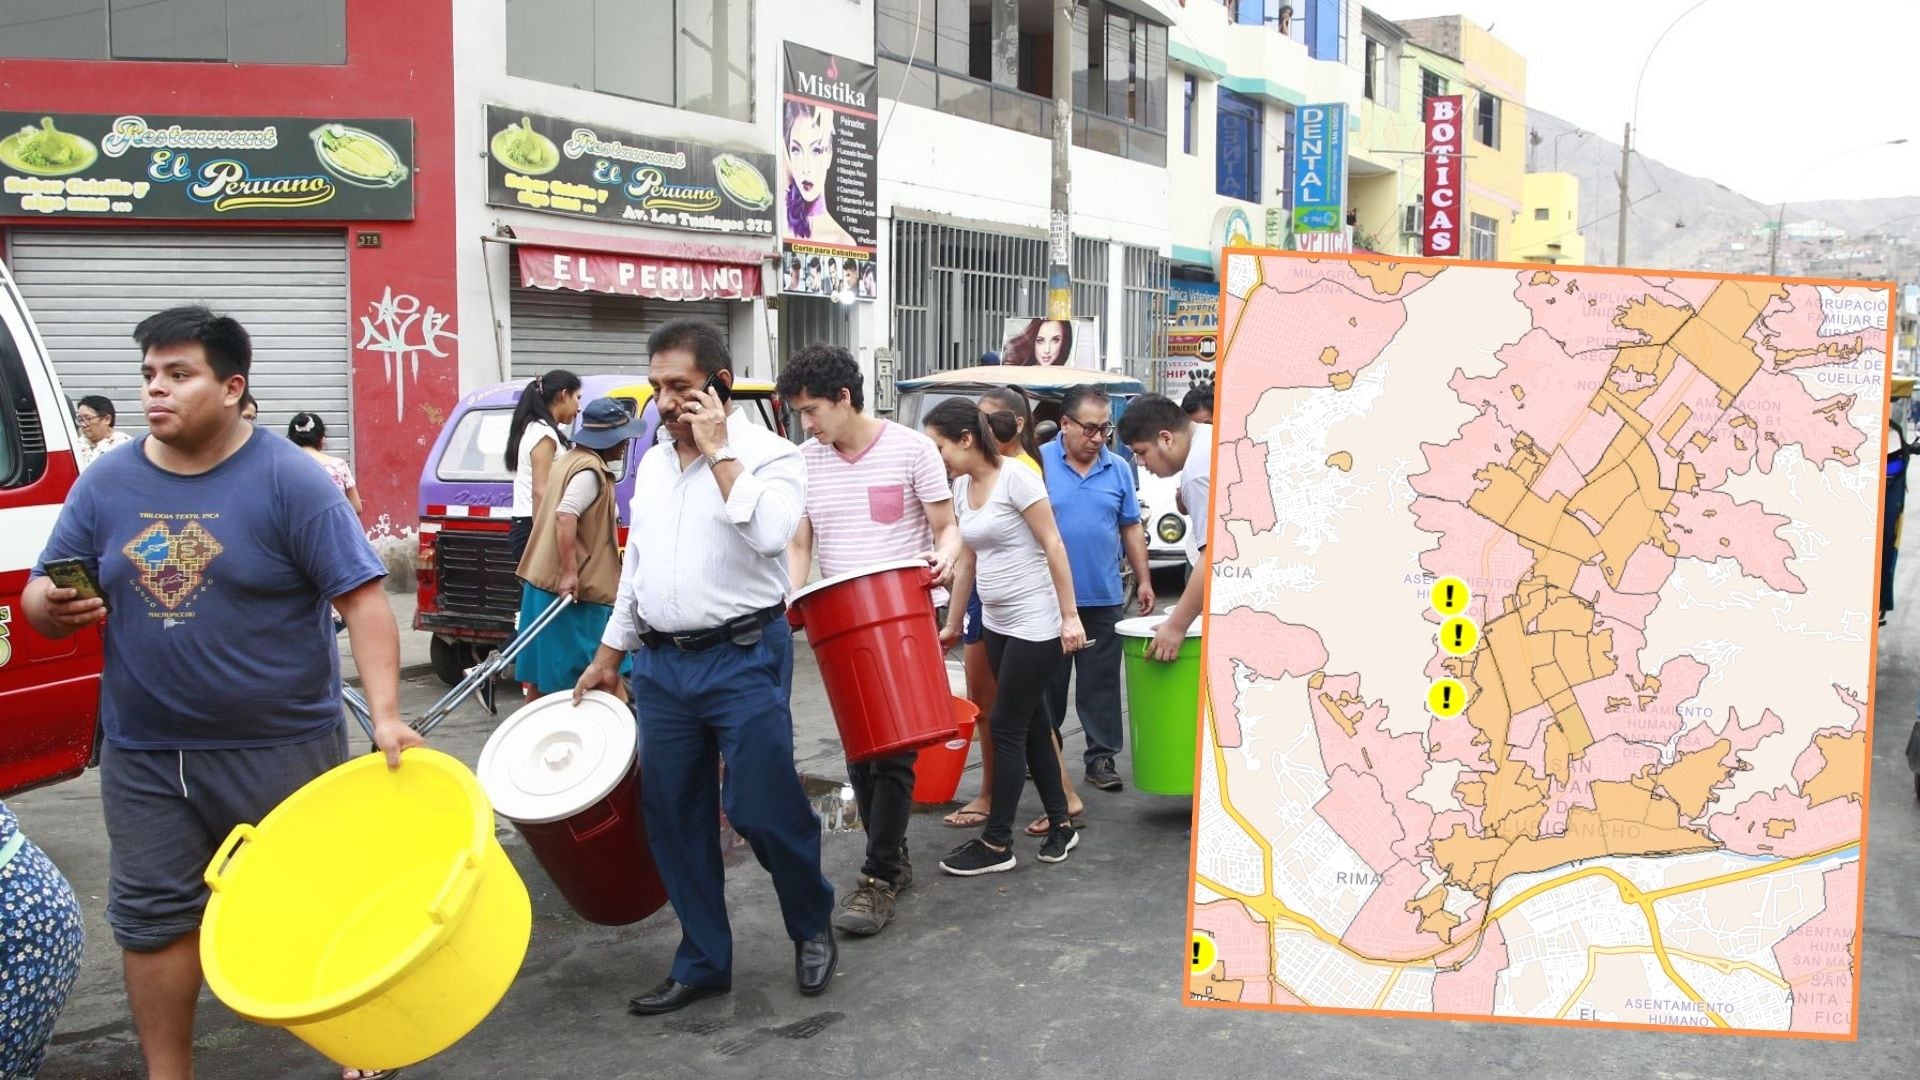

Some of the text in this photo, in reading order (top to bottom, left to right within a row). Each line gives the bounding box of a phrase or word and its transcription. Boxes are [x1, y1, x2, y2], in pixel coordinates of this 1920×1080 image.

[797, 71, 866, 107] Mistika
[102, 116, 278, 157] Restaurant
[563, 128, 686, 170] Restaurant
[1301, 108, 1323, 202] DENTAL
[147, 148, 190, 182] El
[187, 159, 332, 208] Peruano
[593, 160, 622, 183] El
[1431, 101, 1455, 251] BOTICAS
[624, 166, 721, 206] Peruano
[622, 205, 648, 221] Av.
[793, 243, 813, 252] Corte
[814, 246, 830, 254] para
[553, 254, 595, 284] EL
